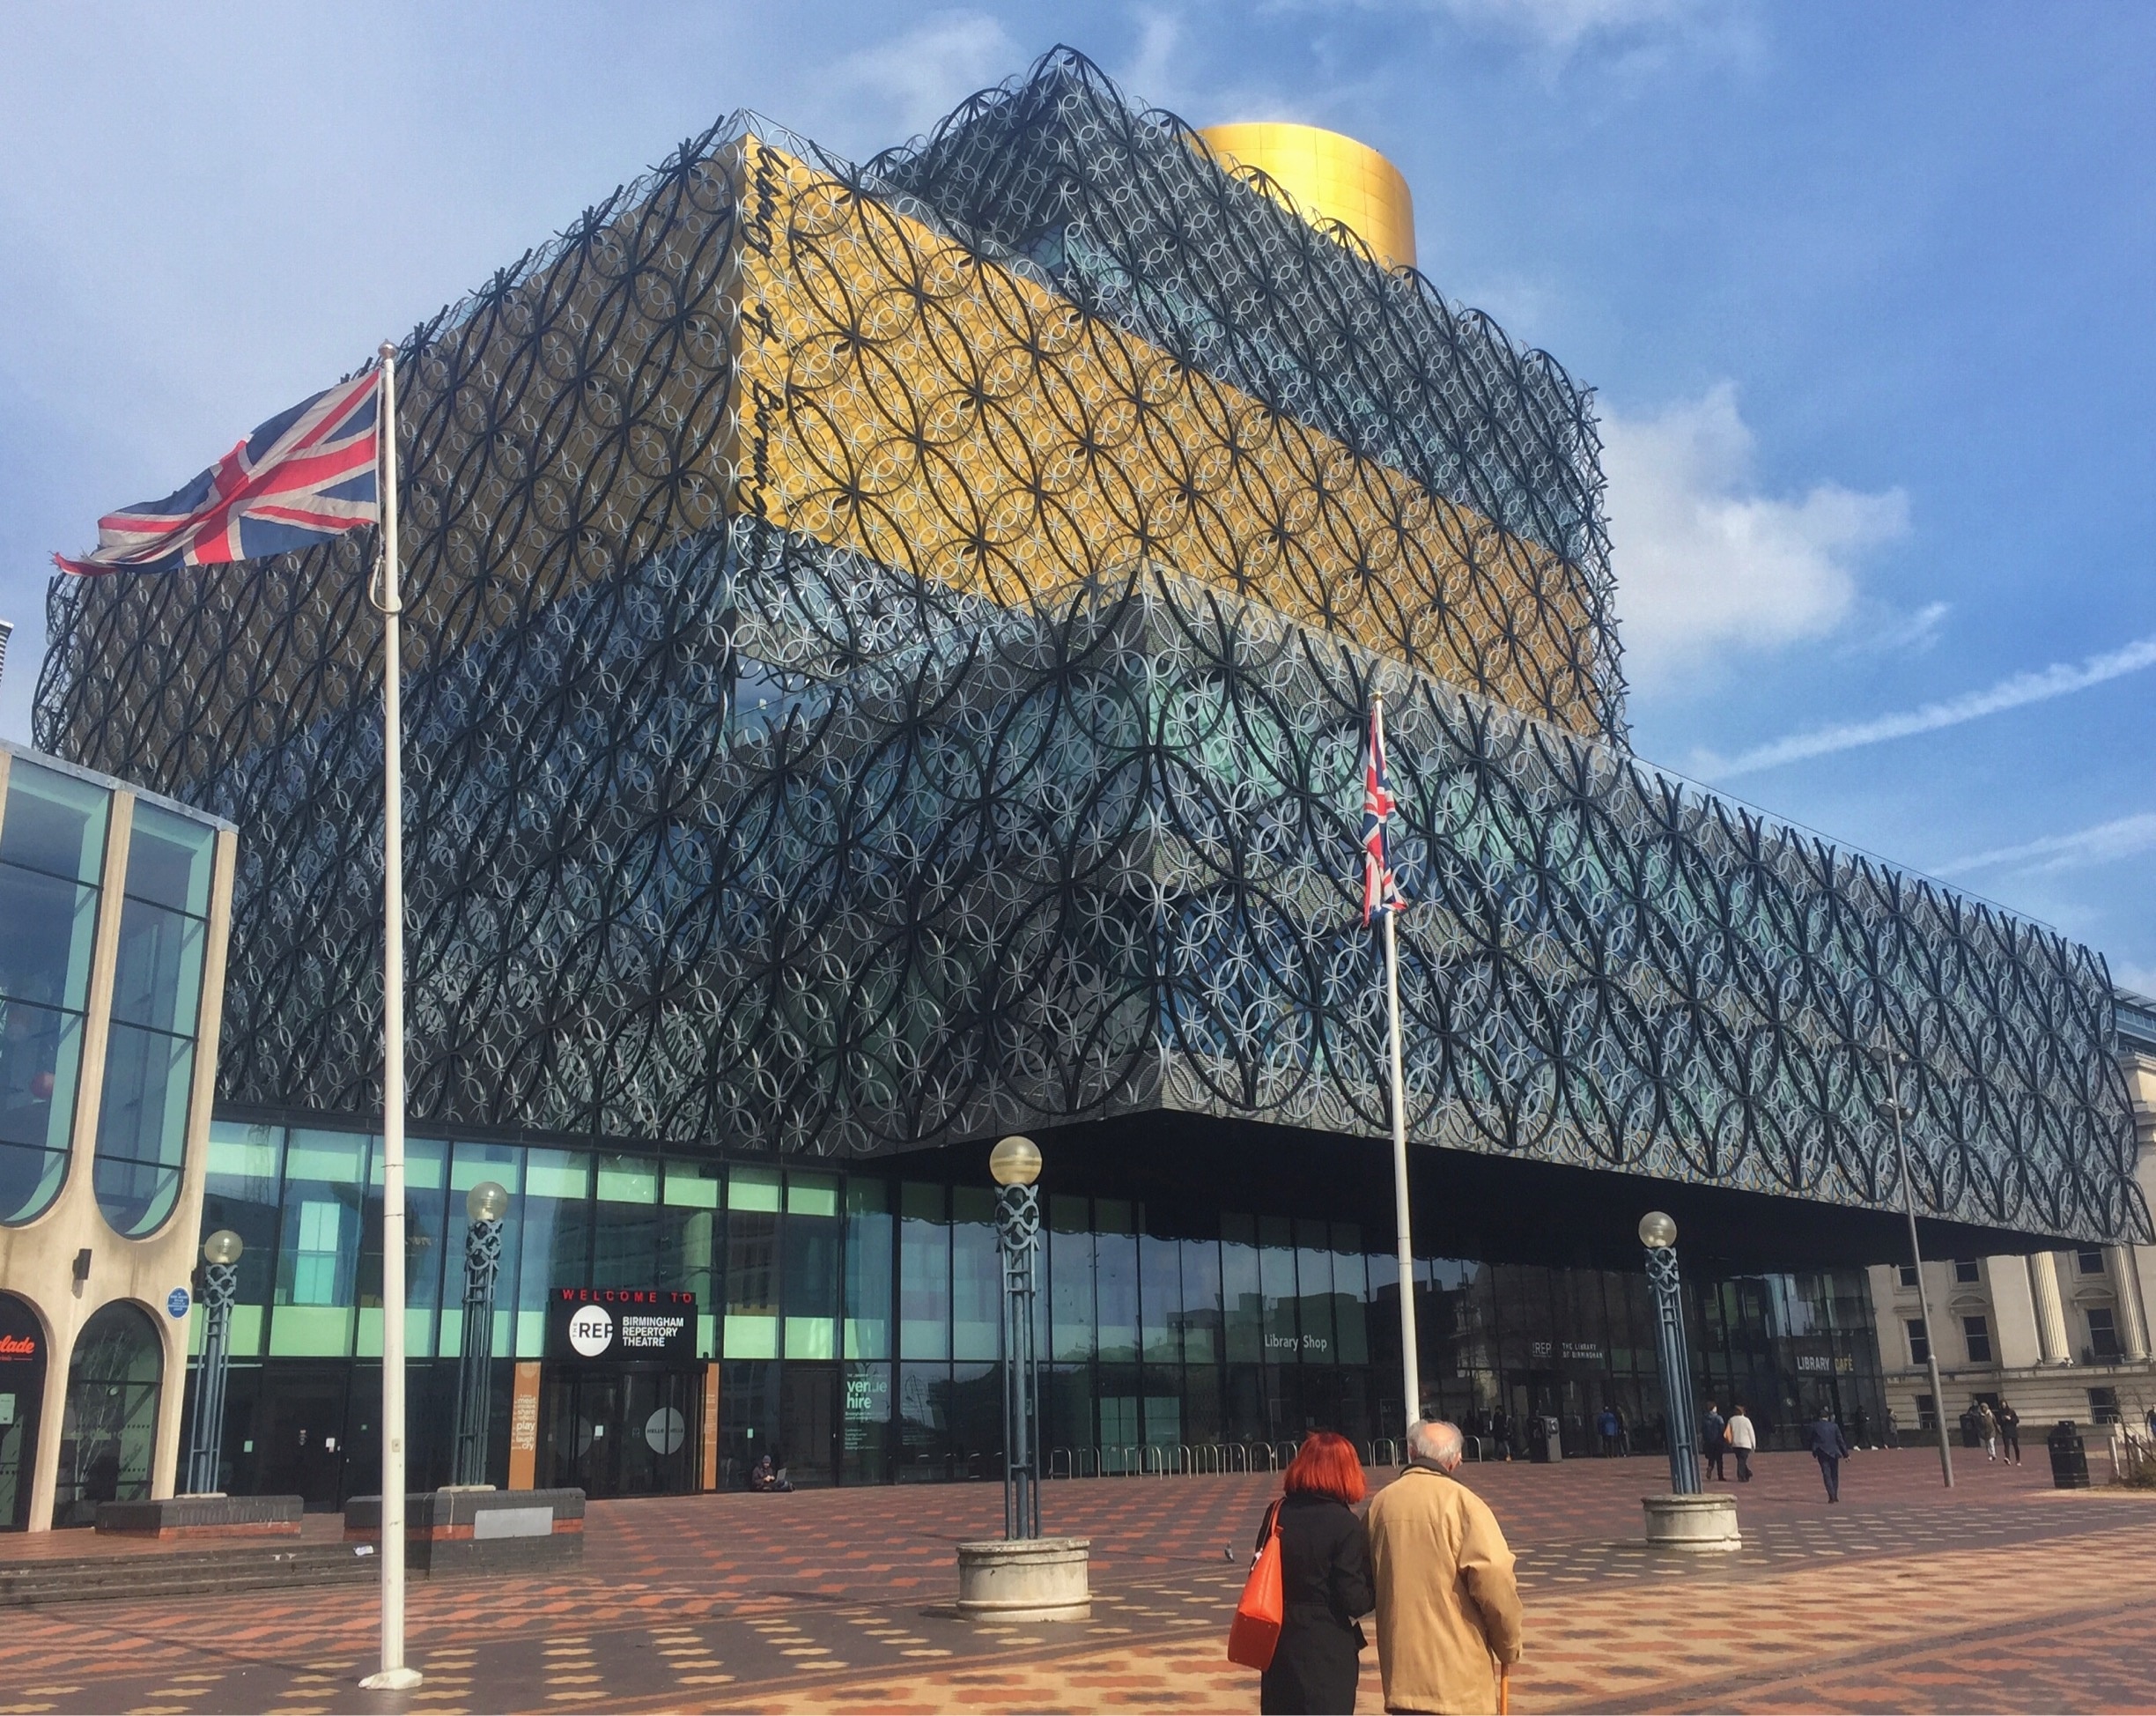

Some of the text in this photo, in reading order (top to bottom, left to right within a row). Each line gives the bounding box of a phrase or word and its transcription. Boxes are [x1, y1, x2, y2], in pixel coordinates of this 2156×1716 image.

[741, 303, 782, 344] of
[563, 1289, 692, 1303] WELCOME TO
[623, 1316, 684, 1328] BIRMINGHAM
[579, 1322, 614, 1338] REP
[623, 1327, 678, 1337] REPERTORY
[0, 1335, 35, 1354] lade
[623, 1337, 666, 1347] THEATRE
[1264, 1333, 1328, 1352] Library Shop
[1535, 1342, 1552, 1354] REP
[1797, 1353, 1854, 1372] LIBRARY CAFÉ
[847, 1381, 887, 1393] venue
[847, 1392, 872, 1408] hire
[516, 1421, 535, 1431] play
[521, 1443, 535, 1452] cry
